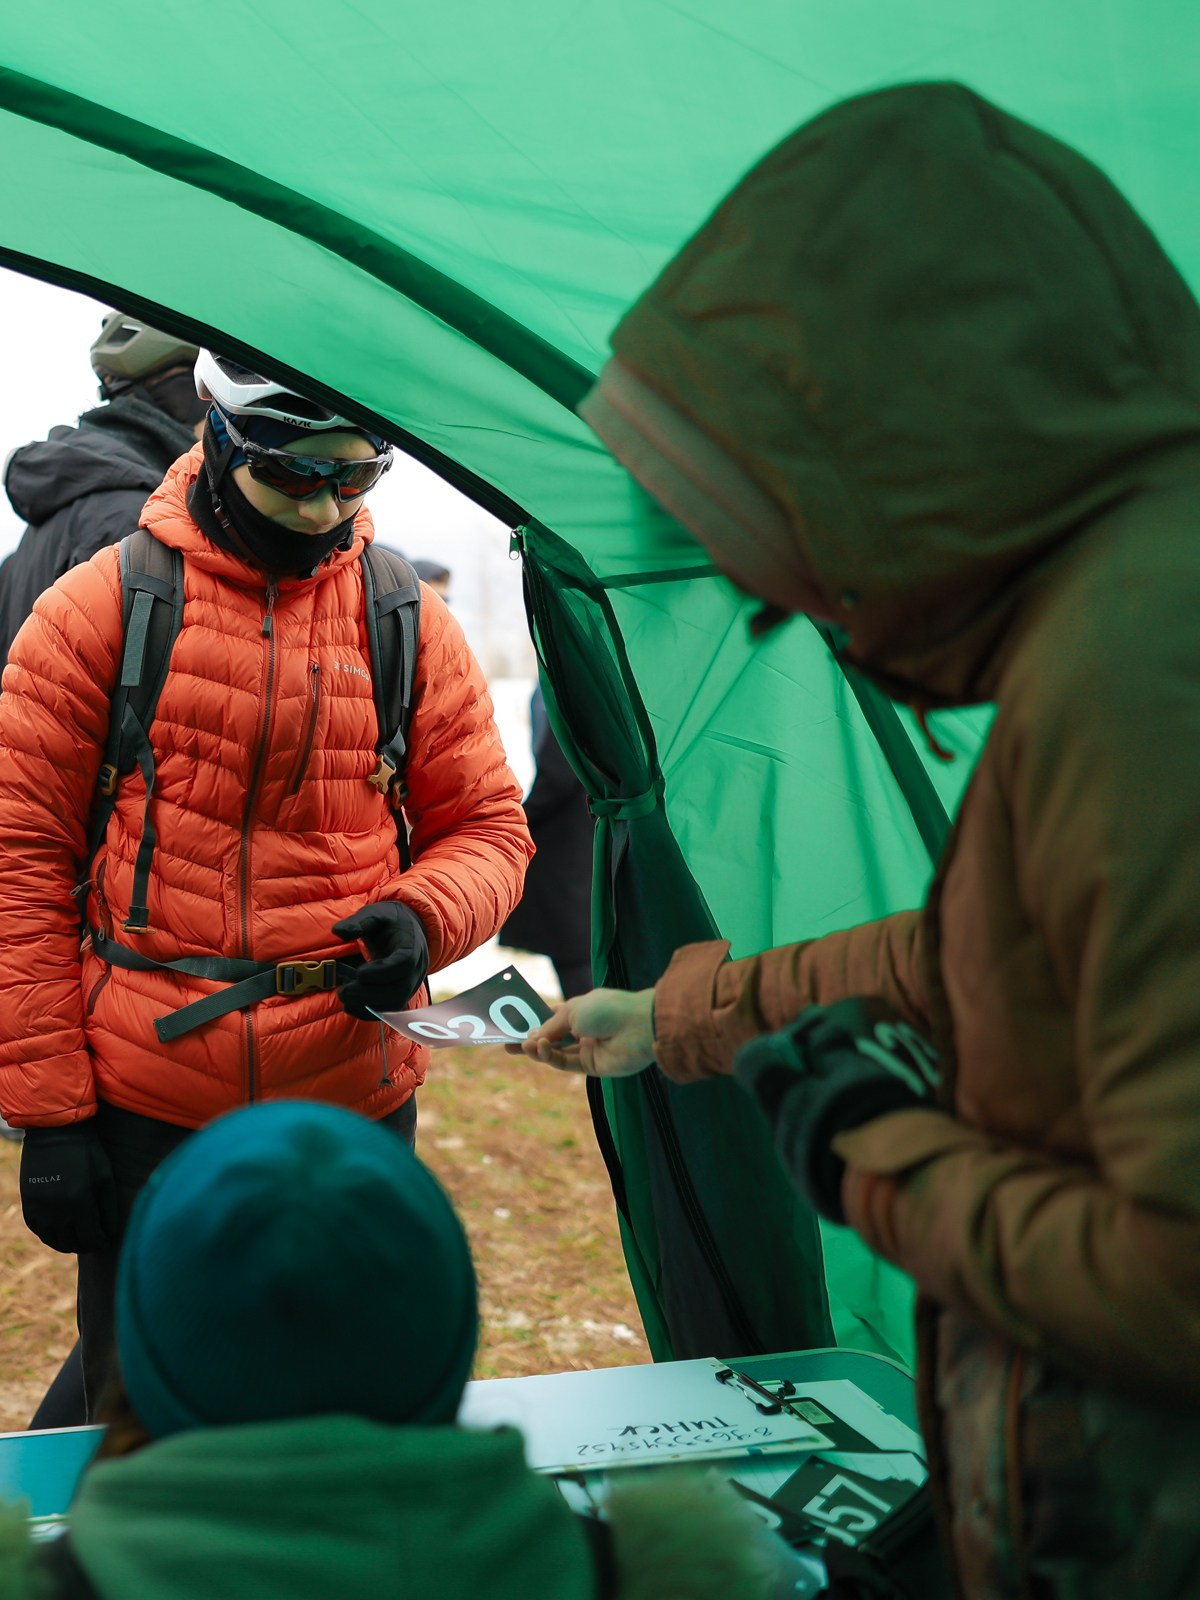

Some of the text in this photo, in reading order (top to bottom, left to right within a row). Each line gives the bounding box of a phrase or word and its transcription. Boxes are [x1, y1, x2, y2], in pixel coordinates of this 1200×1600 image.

[283, 416, 312, 428] KASK
[407, 995, 542, 1040] 020
[28, 1174, 61, 1184] FORCLAZ
